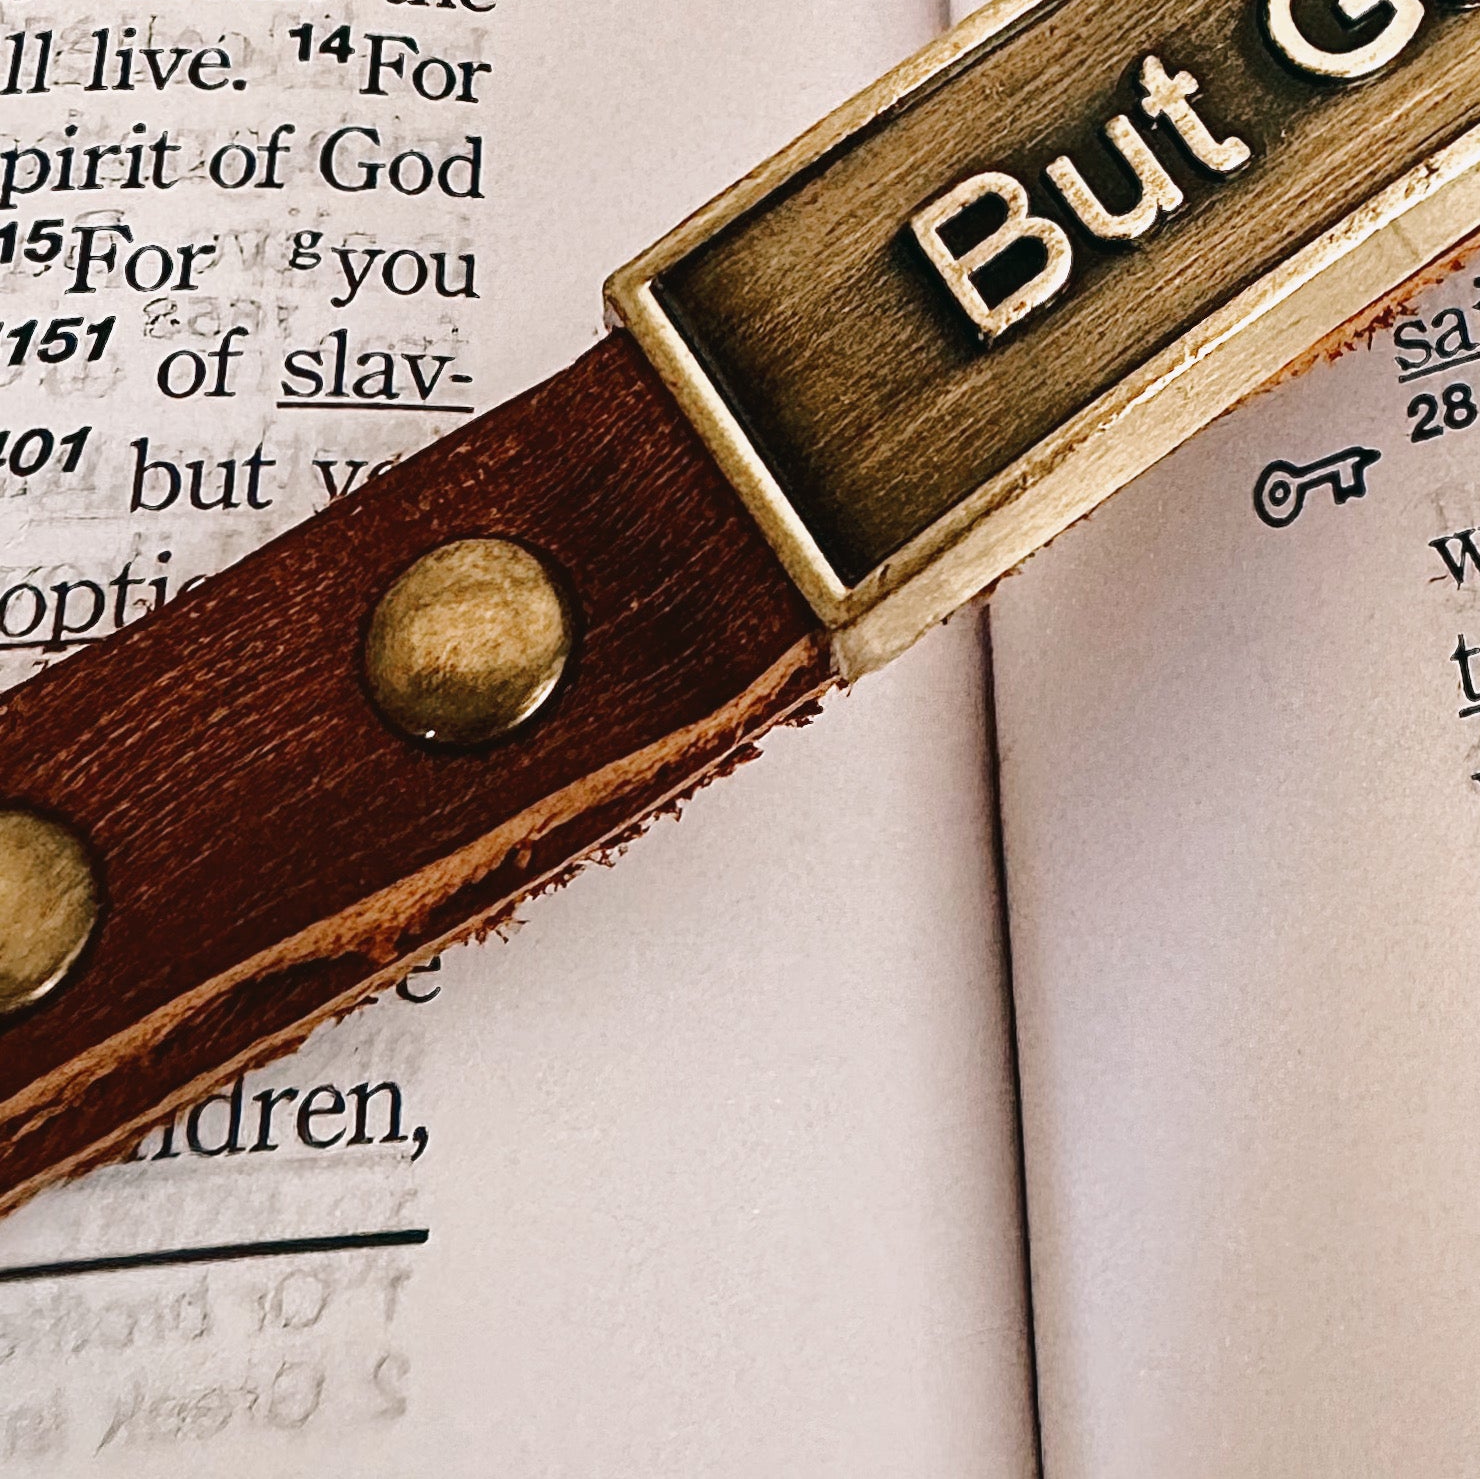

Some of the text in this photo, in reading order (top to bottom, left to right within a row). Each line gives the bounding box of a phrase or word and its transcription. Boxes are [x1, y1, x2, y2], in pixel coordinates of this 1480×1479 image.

[85, 27, 247, 92] live.
[209, 125, 295, 190] of
[320, 126, 486, 199] God
[908, 53, 1253, 343] But
[157, 327, 473, 402] of slav-
[131, 437, 277, 513] but
